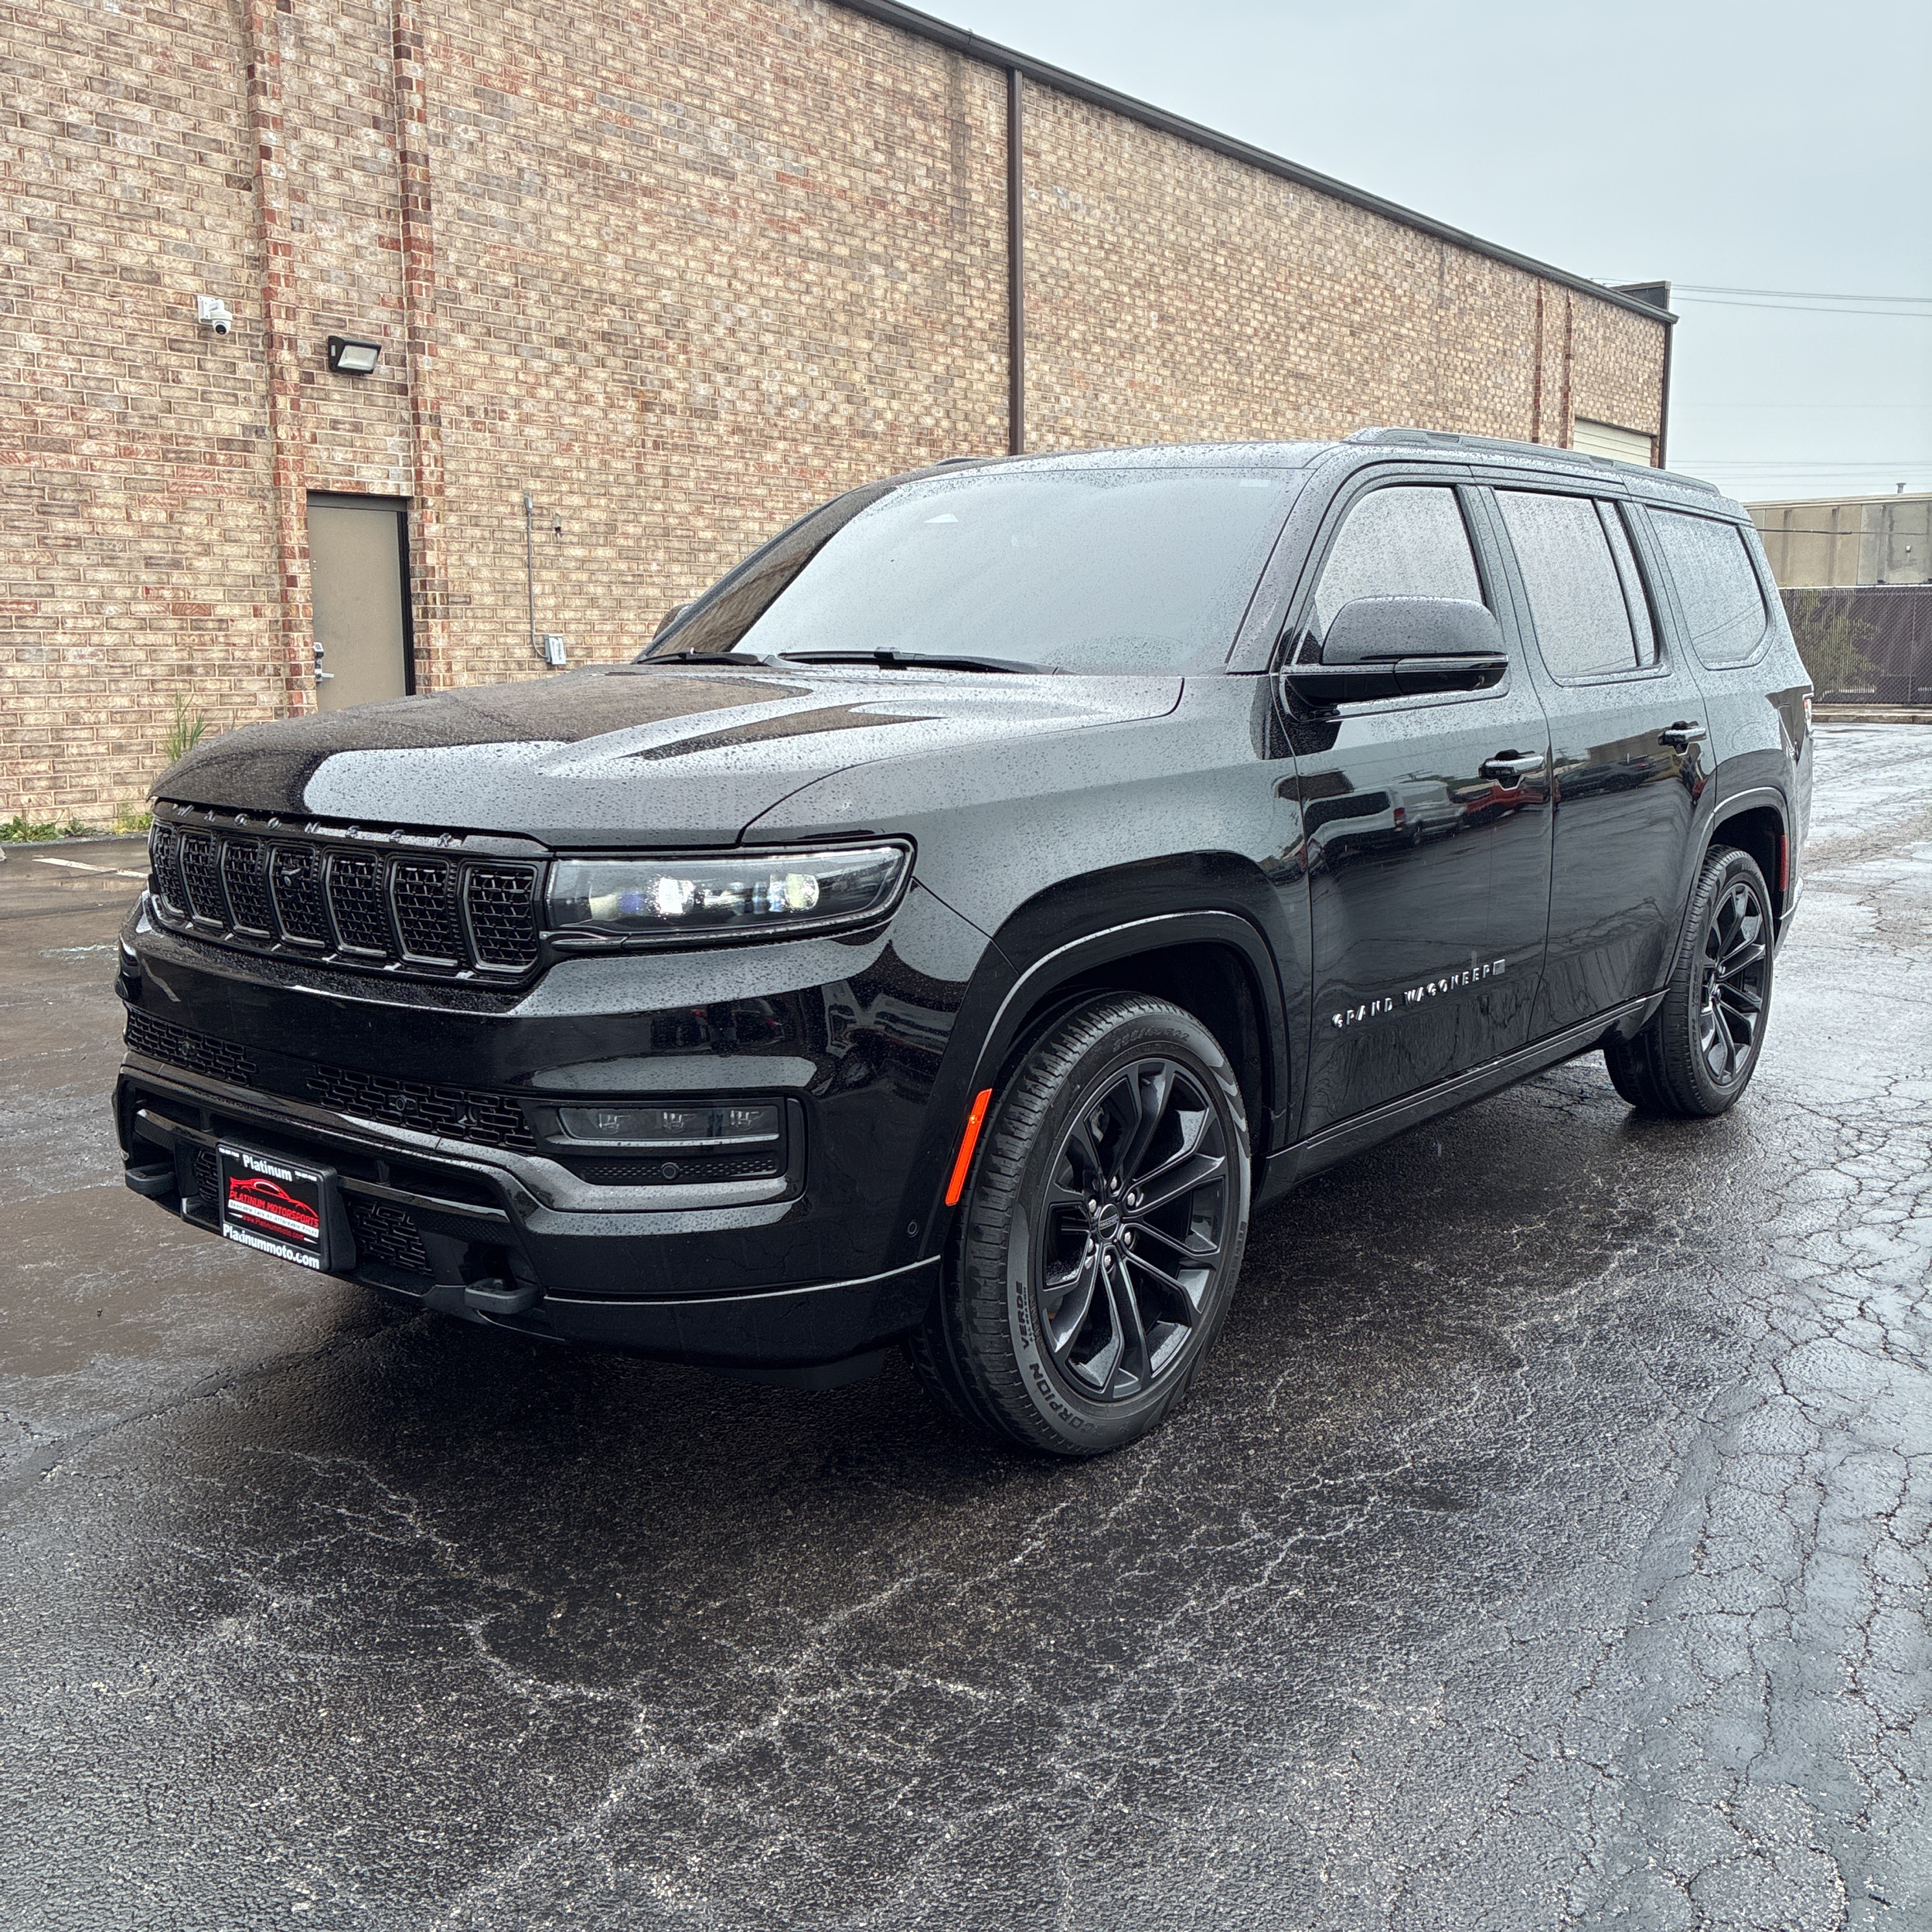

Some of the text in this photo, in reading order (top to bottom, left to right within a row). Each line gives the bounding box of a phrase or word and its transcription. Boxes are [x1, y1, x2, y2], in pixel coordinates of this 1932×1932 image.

[172, 802, 453, 848] WAGONEER
[1331, 964, 1491, 1028] GRAND WAGONEER
[243, 1153, 293, 1182] Platinum
[229, 1191, 319, 1228] PLATINUM MOTORSPORTS
[223, 1223, 319, 1269] Platinummoto.com
[1016, 1280, 1107, 1436] SCORPION VERDE
